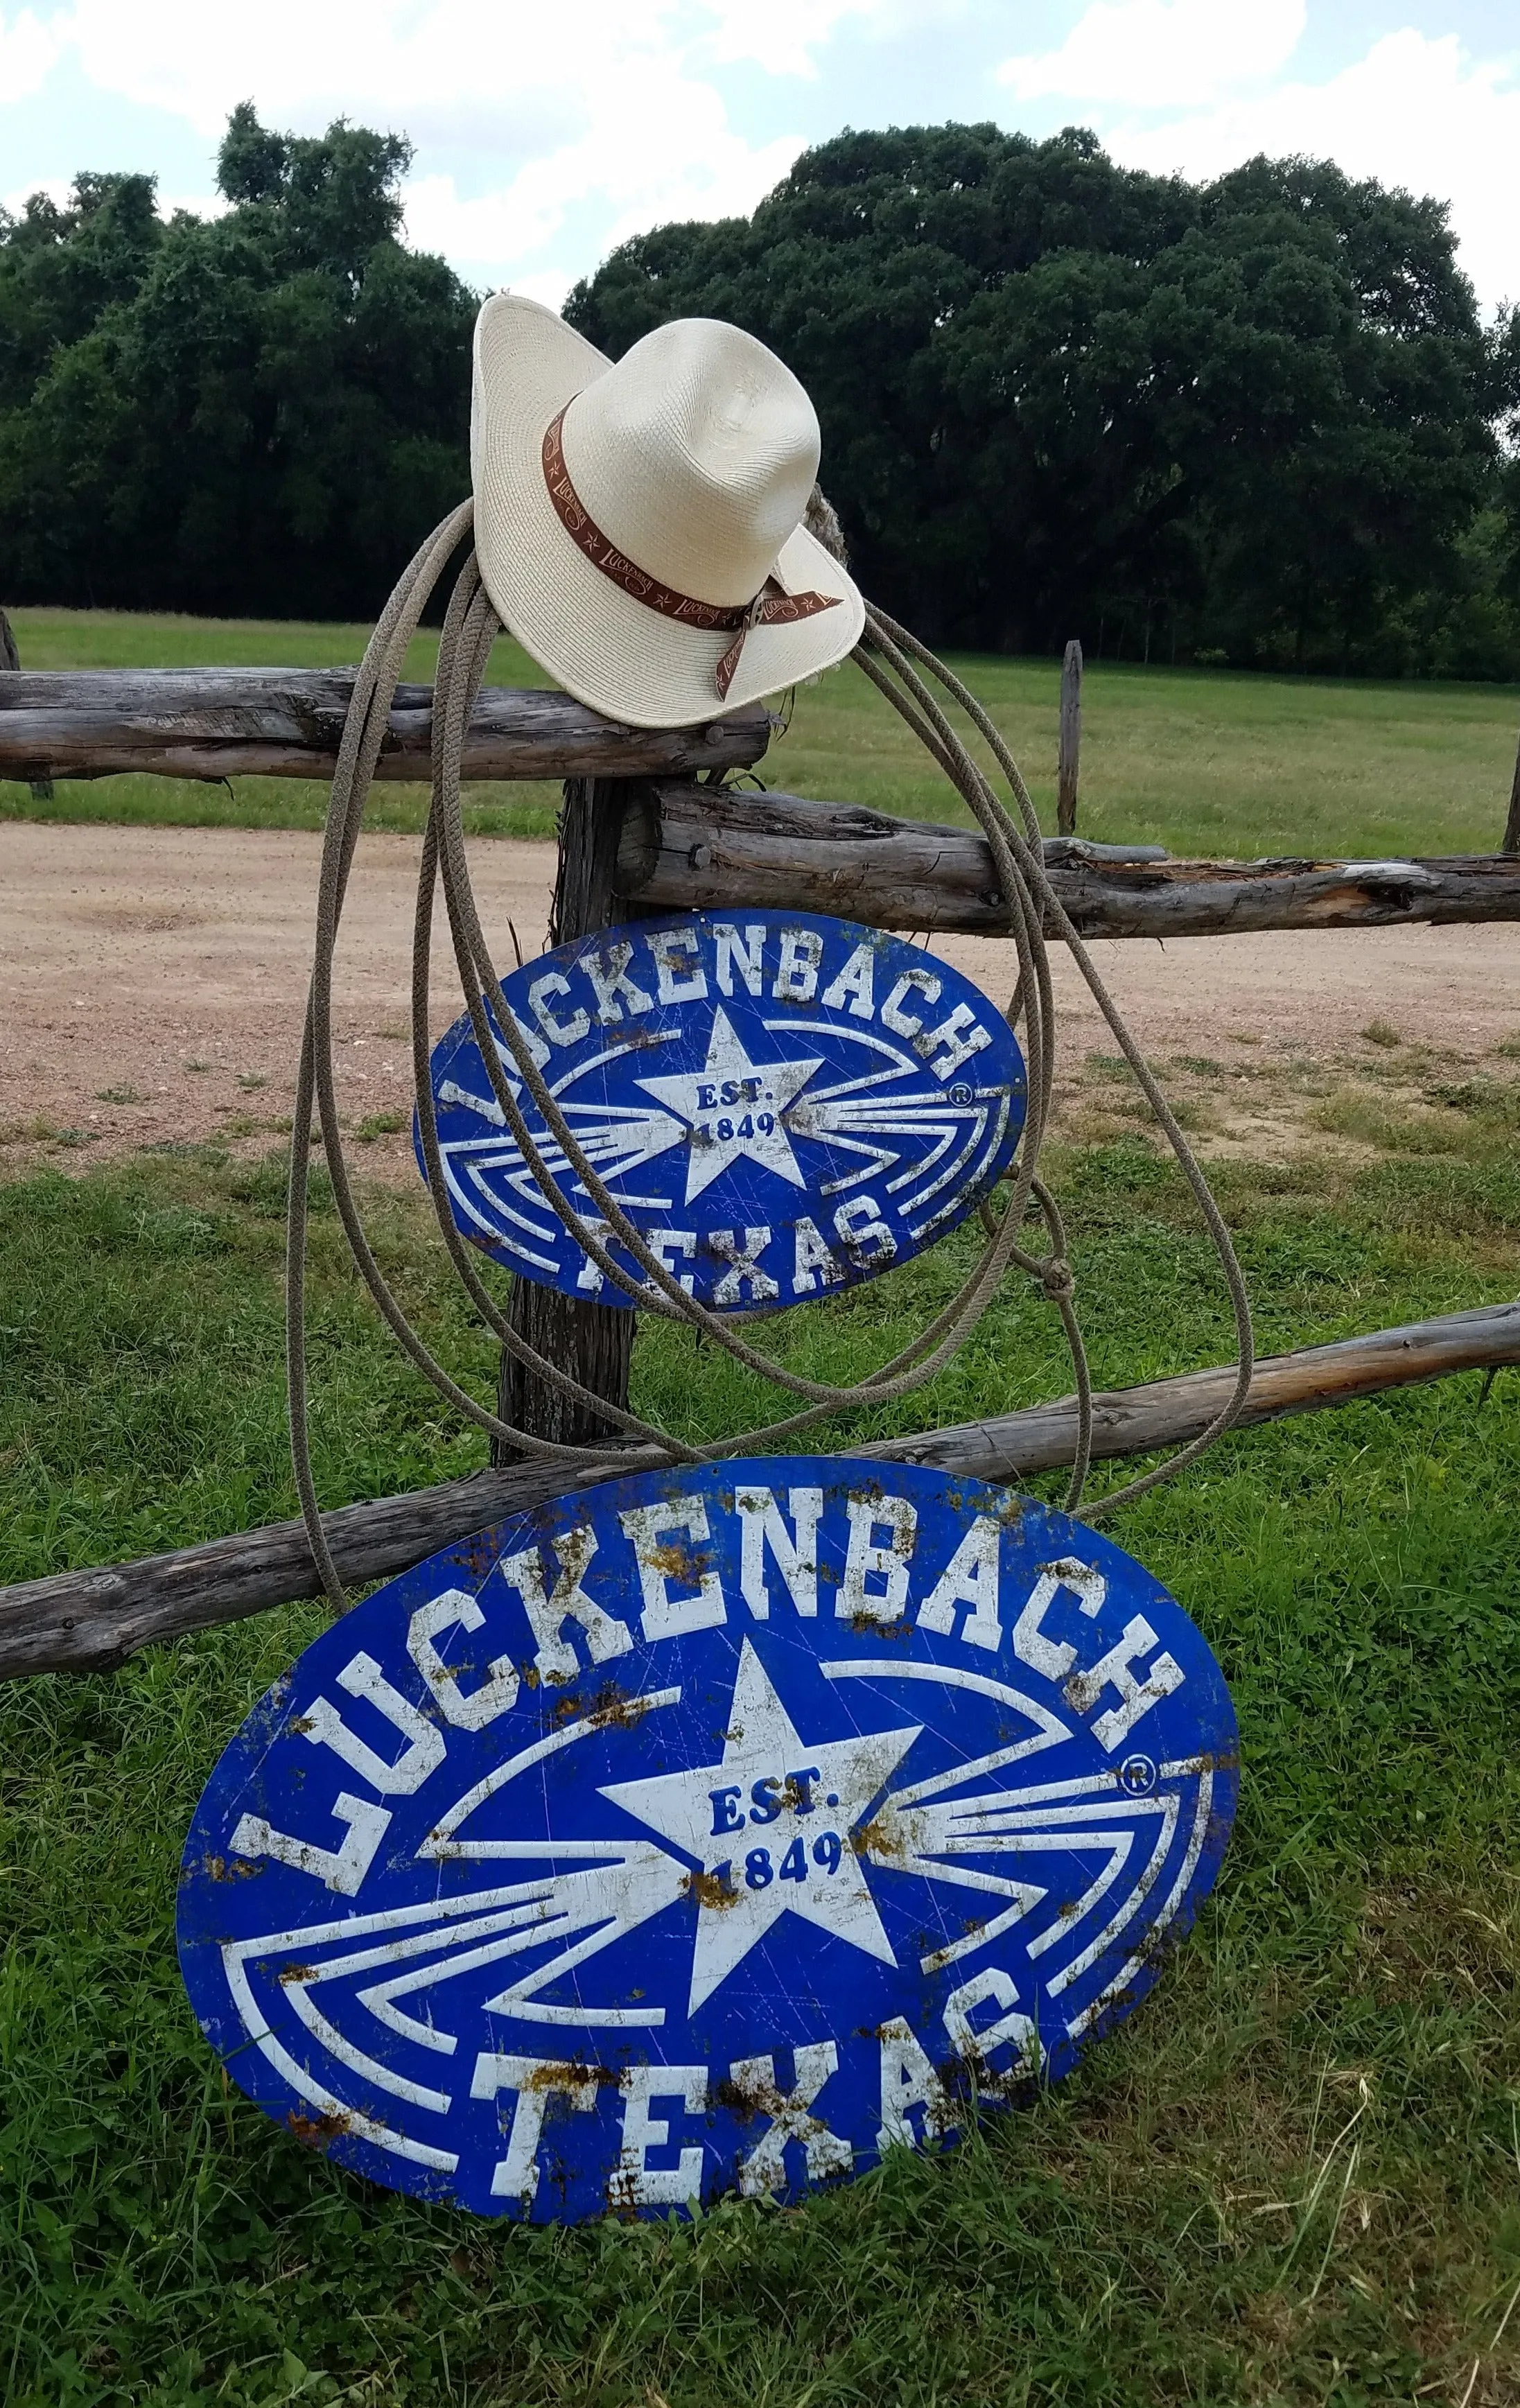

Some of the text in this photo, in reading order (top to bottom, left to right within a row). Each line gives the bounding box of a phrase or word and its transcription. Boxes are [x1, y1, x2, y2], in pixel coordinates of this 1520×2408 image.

[598, 546, 654, 595] LUCKENBACH
[695, 1112, 775, 1144] 1849
[696, 1076, 774, 1110] EST.
[565, 1194, 898, 1306] TEXAS
[229, 1485, 1185, 1897] LUCKENBACH
[708, 1765, 839, 1836] EST.
[707, 1830, 843, 1901] 1849
[470, 1967, 1047, 2207] TEXAS
